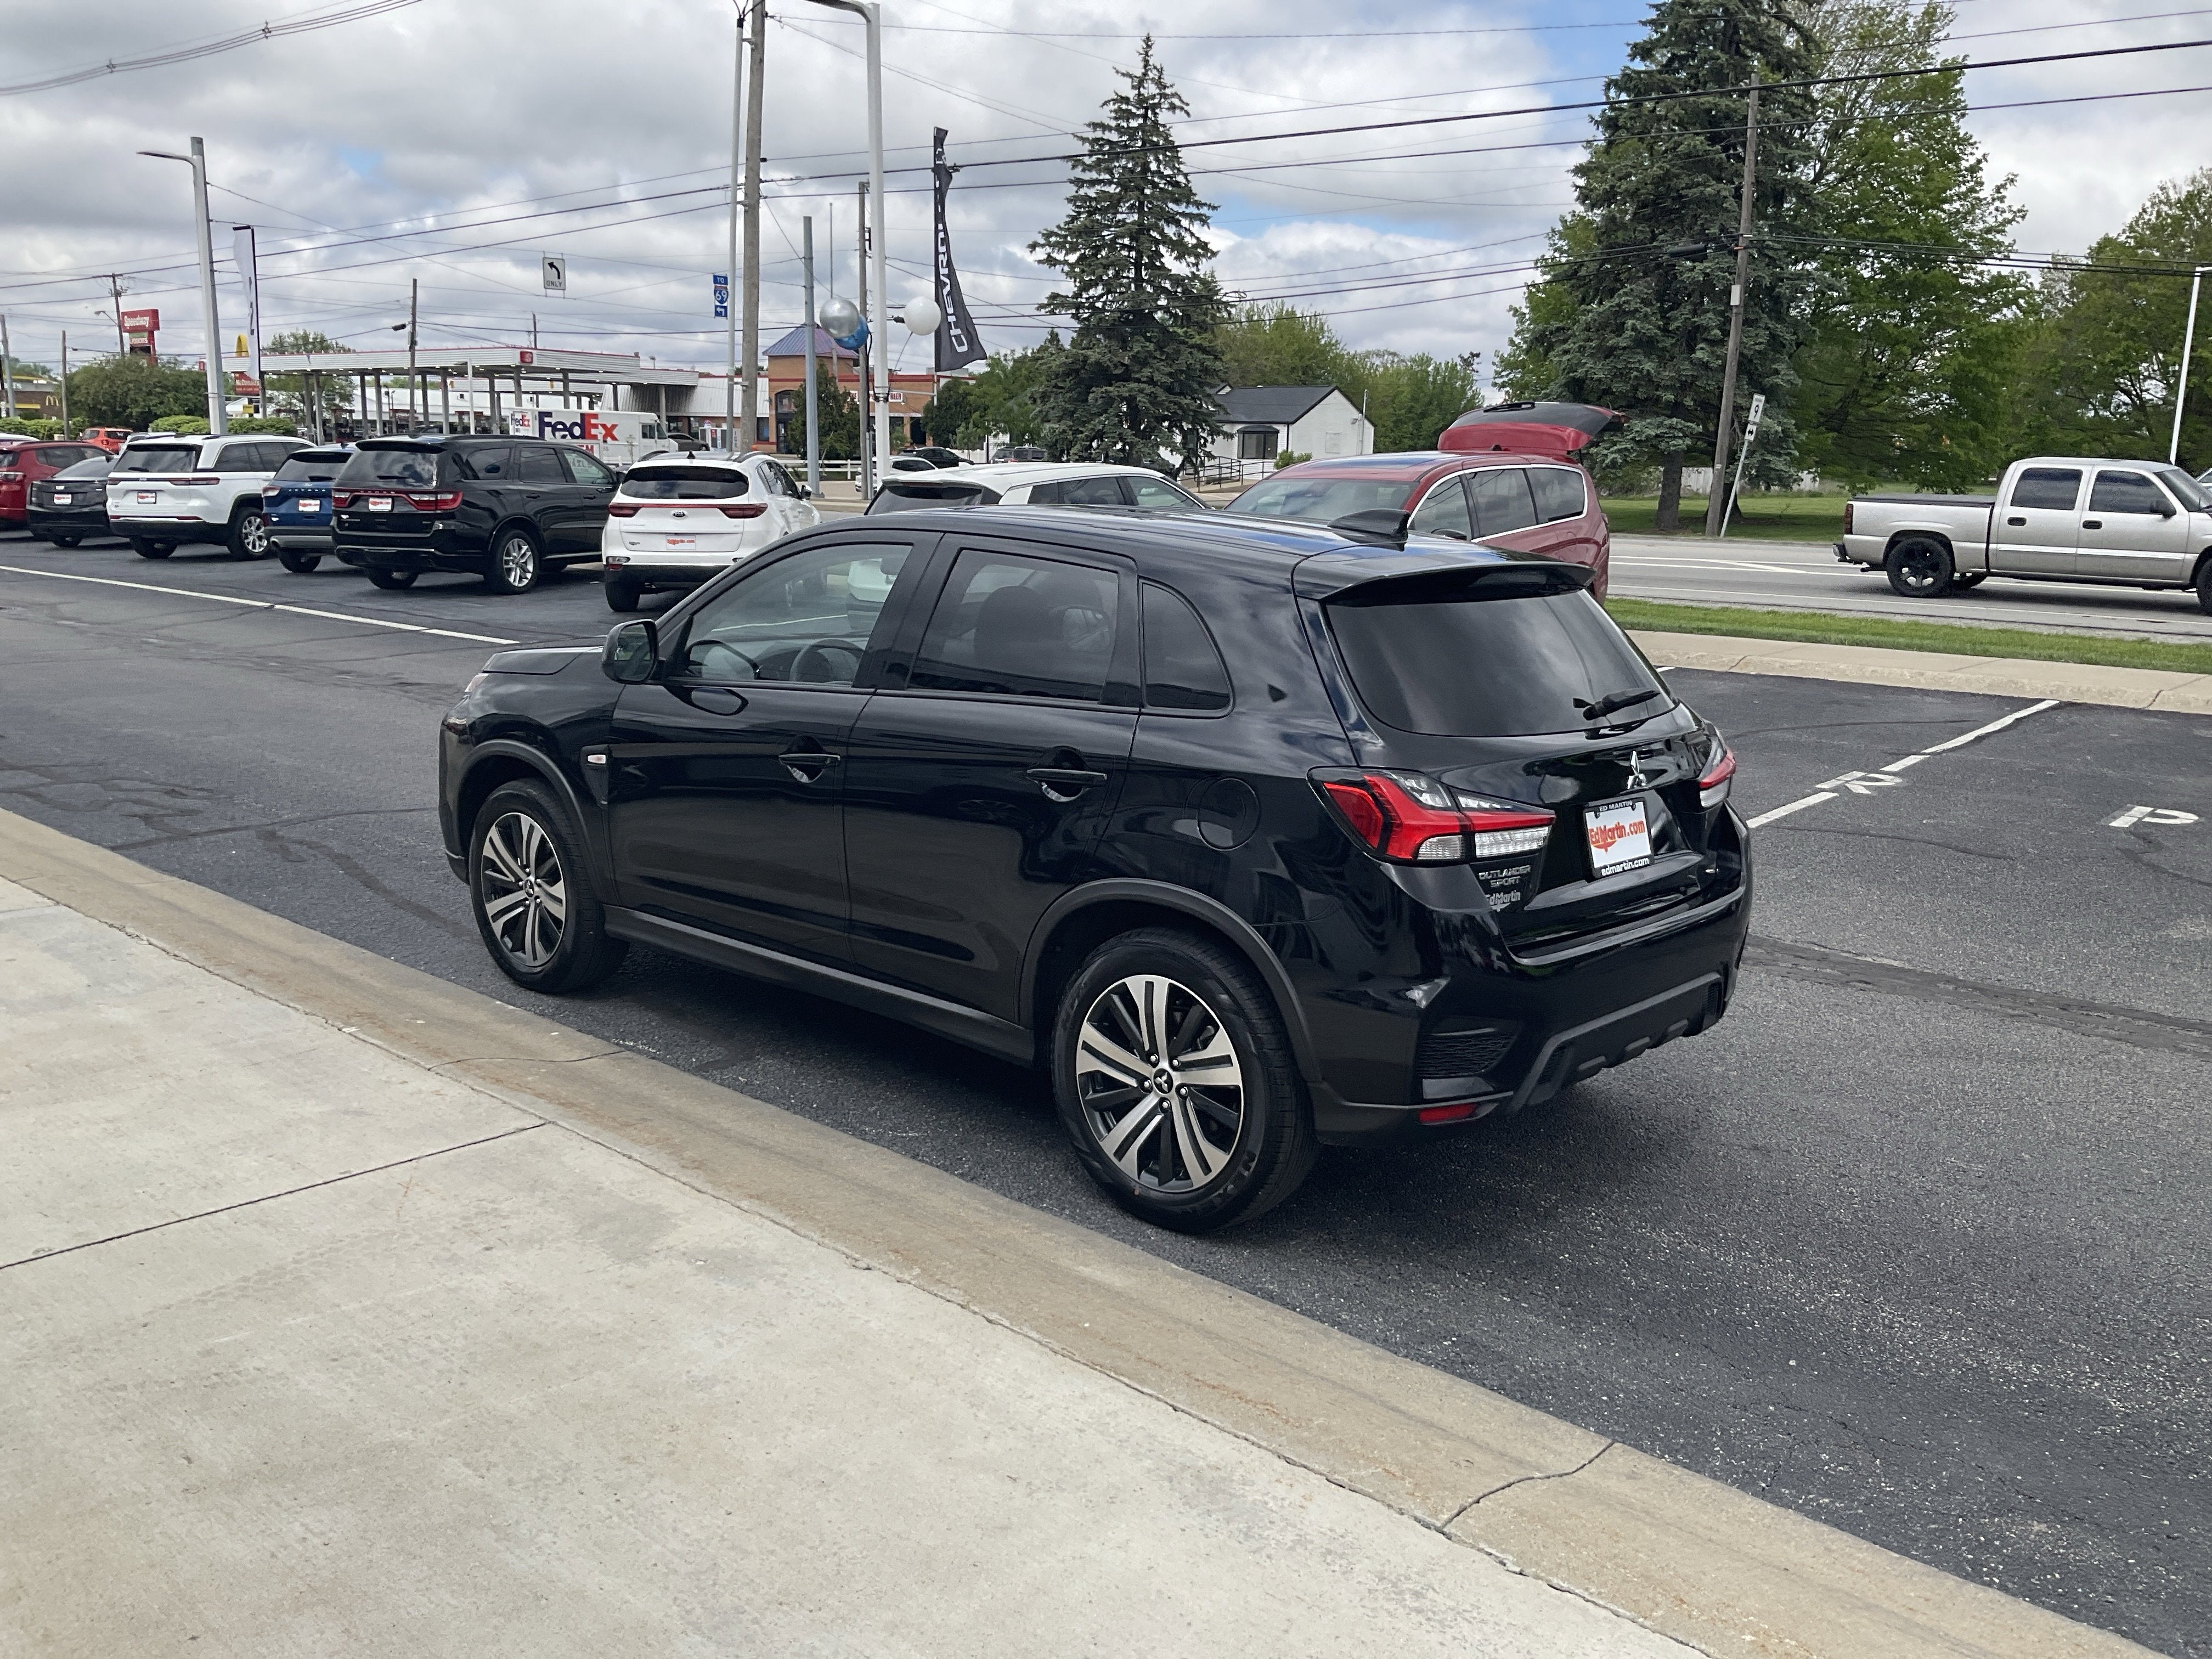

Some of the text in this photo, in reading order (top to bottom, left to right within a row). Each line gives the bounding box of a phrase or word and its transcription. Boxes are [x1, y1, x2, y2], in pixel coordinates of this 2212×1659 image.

[715, 290, 727, 301] 69
[1753, 404, 1759, 419] 9
[510, 413, 531, 427] FedEx
[538, 411, 619, 442] FedEx
[1609, 800, 1633, 810] MARTIN
[1589, 821, 1646, 847] EdMartin.com
[1479, 865, 1531, 881] OUTLANDER
[1601, 857, 1650, 876] edmartin.com
[1489, 876, 1521, 888] SPORT
